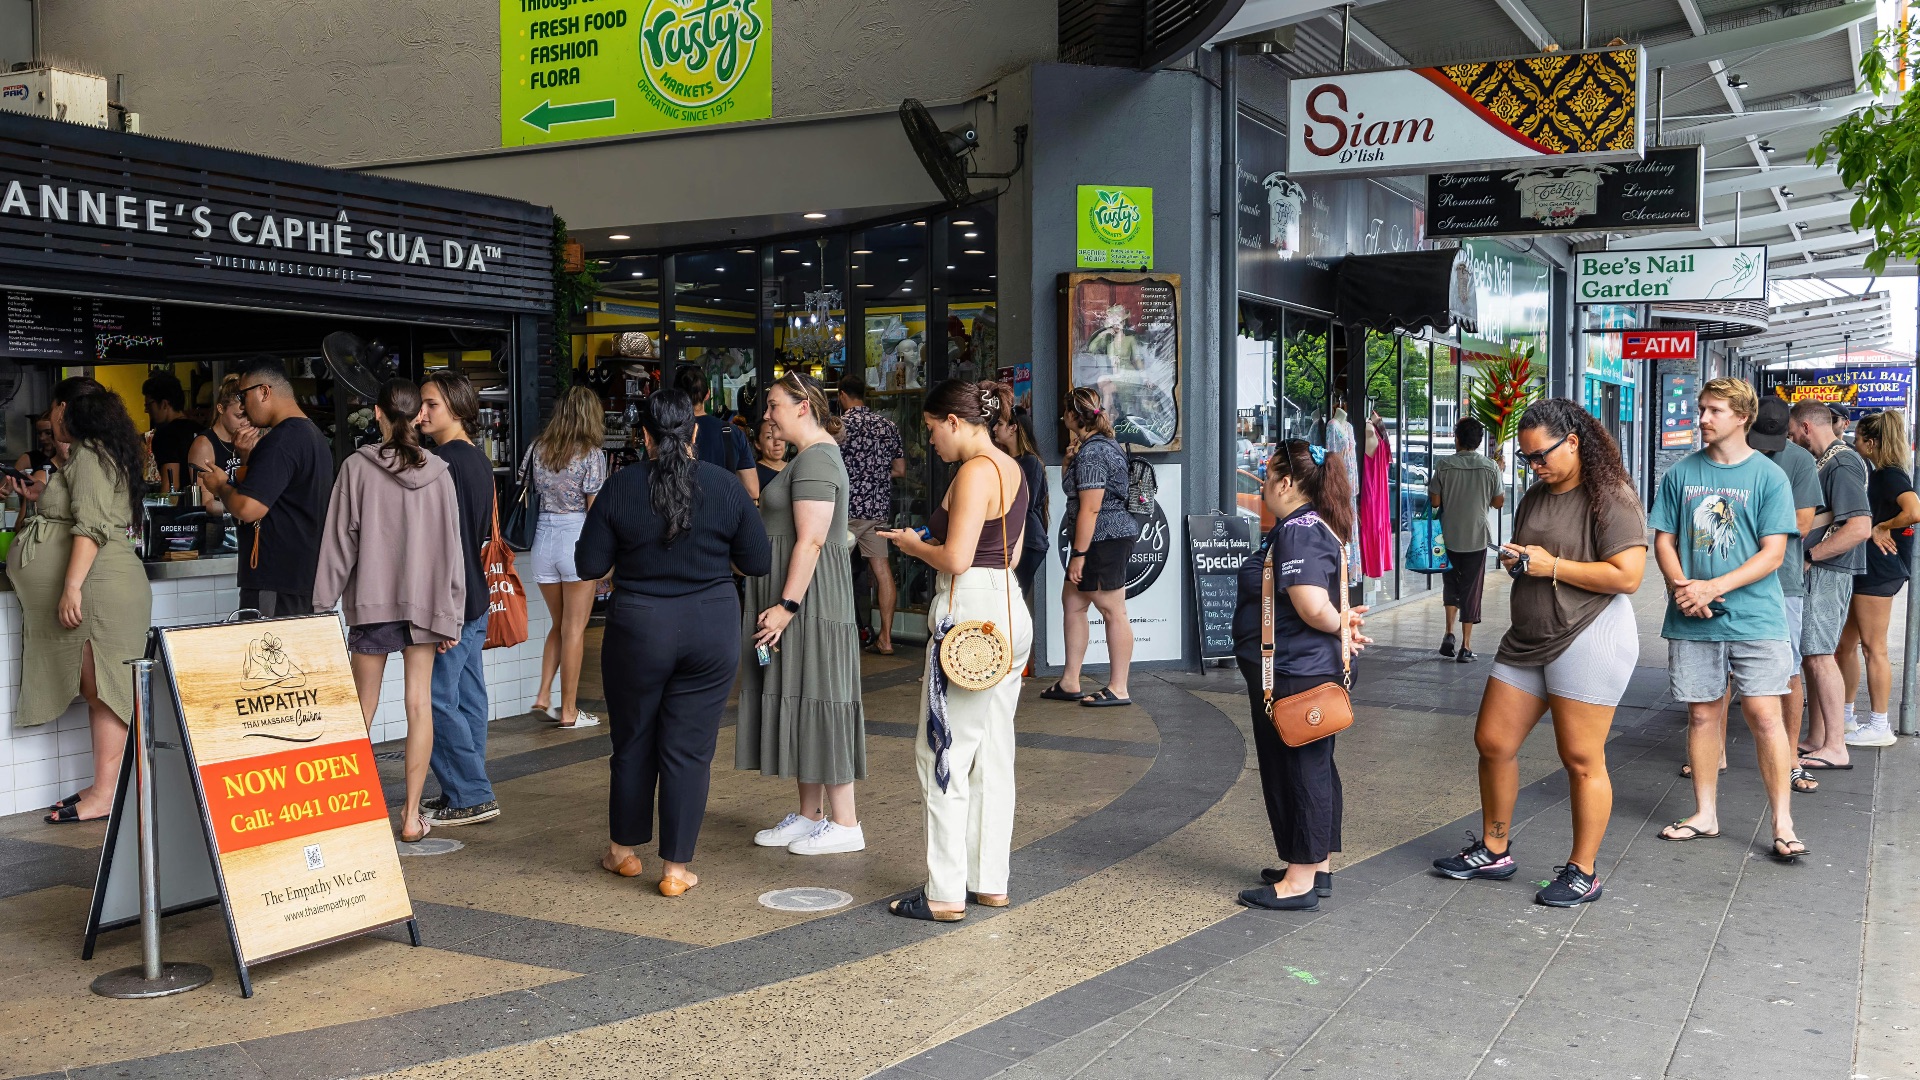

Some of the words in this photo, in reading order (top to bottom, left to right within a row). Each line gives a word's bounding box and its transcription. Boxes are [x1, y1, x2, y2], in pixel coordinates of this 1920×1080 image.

[530, 15, 579, 40] FRESH
[584, 10, 627, 31] FOOD
[530, 39, 598, 65] FASHION
[530, 67, 580, 90] FLORA
[660, 72, 713, 97] MARKETS
[638, 79, 680, 119] OPERATING
[681, 109, 708, 121] SINCE
[710, 97, 735, 117] 1975
[1304, 83, 1434, 156] Siam
[1338, 148, 1385, 163] D'lish
[1623, 160, 1675, 175] Clothing
[1438, 173, 1490, 187] Gorgeous
[1438, 193, 1495, 207] Romantic
[1621, 183, 1675, 201] Lingerie
[1, 180, 212, 238] ANNEE'S
[228, 209, 352, 255] CAPHÊ
[366, 229, 430, 266] SUA
[1094, 198, 1140, 234] rusty's
[1437, 216, 1499, 229] Irresistible
[1621, 206, 1690, 220] Accessories
[216, 255, 301, 276] VIETNAMESE
[308, 265, 354, 280] COFFEE
[1582, 256, 1641, 276] Bee's
[1646, 254, 1694, 274] Nail
[1582, 279, 1669, 298] Garden
[1644, 336, 1690, 353] ATM
[1817, 370, 1876, 386] CRYSTAL
[1797, 386, 1835, 394] LUCKY
[1684, 485, 1714, 503] THRILLS
[1716, 487, 1750, 508] COMPANY
[235, 689, 318, 716] EMPATHY
[242, 721, 260, 729] THAI
[260, 715, 295, 727] MASSAGE
[222, 766, 287, 799] NOW
[295, 753, 360, 785] OPEN
[230, 808, 275, 833] Call:
[279, 798, 324, 823] 4041
[328, 789, 371, 813] 0272
[261, 891, 285, 907] The
[285, 878, 332, 903] Empathy
[333, 874, 353, 887] We
[354, 868, 377, 884] Care
[284, 894, 366, 922] www.thaiempathy.com
